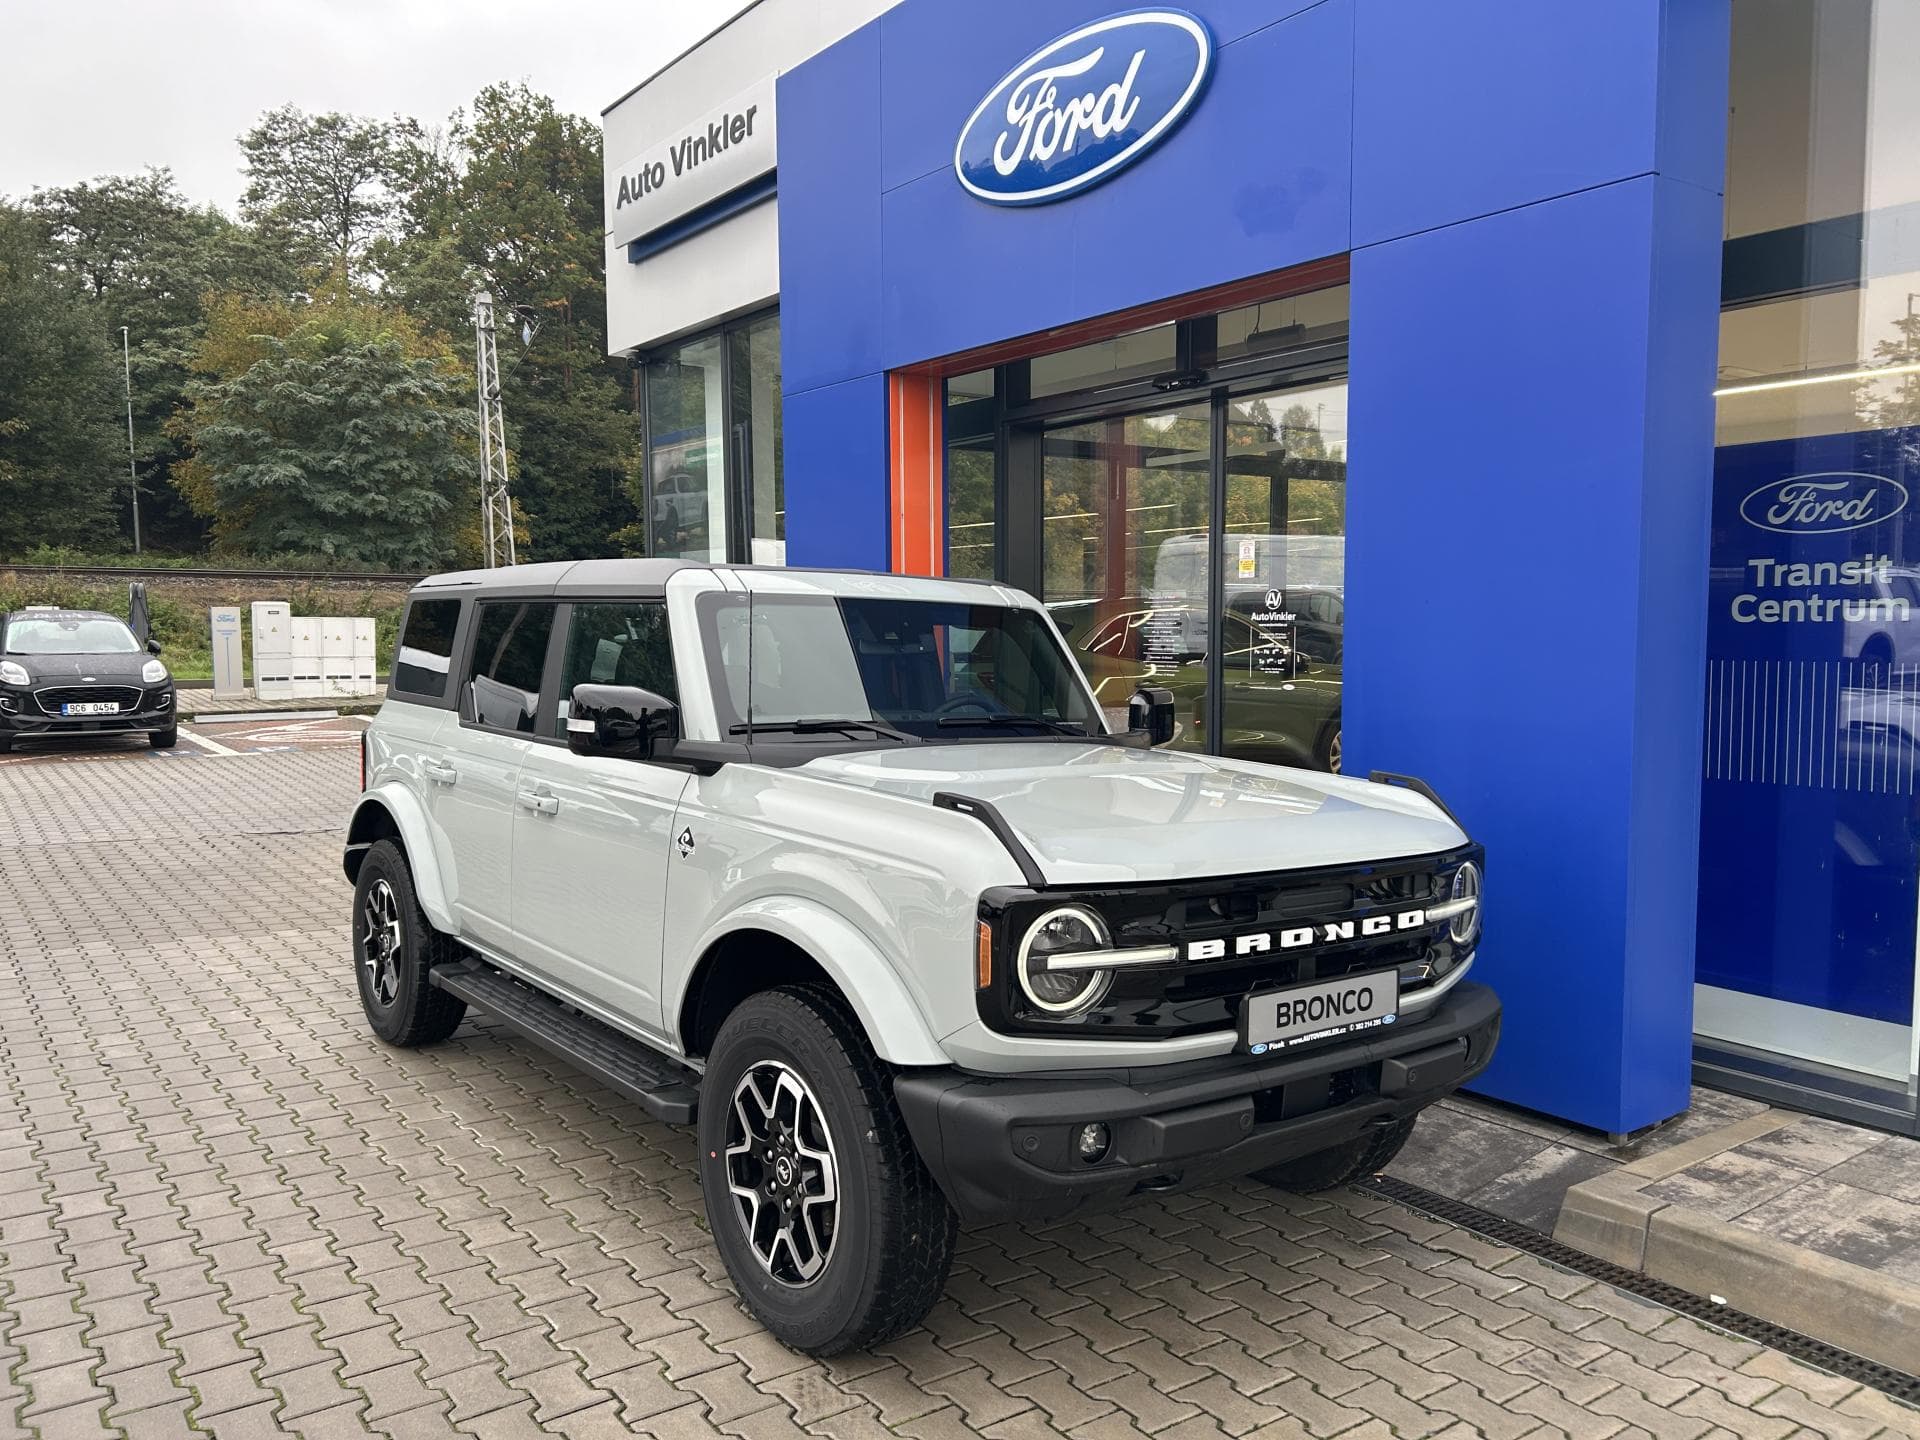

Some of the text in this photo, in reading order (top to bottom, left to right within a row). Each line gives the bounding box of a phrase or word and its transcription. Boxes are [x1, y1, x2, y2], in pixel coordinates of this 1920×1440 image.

[993, 46, 1146, 176] Ford
[616, 104, 757, 210] Auto Vinkler
[1767, 481, 1877, 525] Ford
[1748, 554, 1893, 588] Transit
[1251, 612, 1296, 621] AutoVinkler
[1731, 593, 1910, 623] Centrum
[69, 703, 115, 713] 9C6 0454
[1188, 910, 1425, 961] BRONCO
[1276, 987, 1373, 1028] BRONCO
